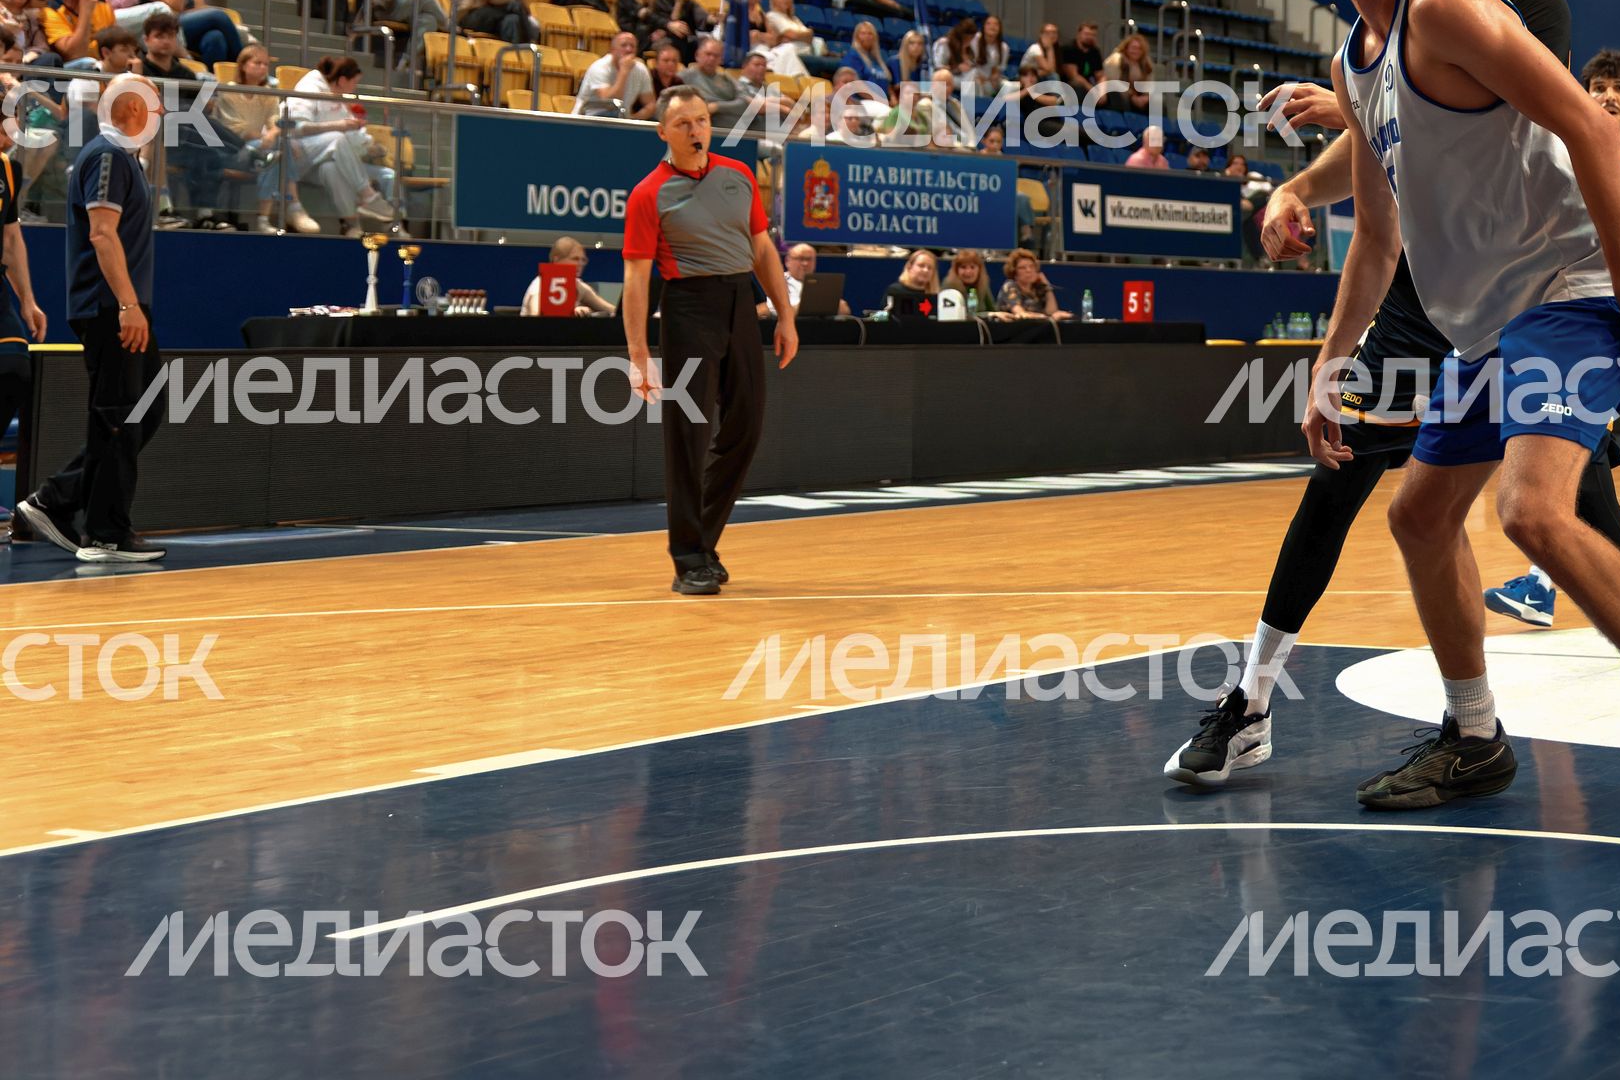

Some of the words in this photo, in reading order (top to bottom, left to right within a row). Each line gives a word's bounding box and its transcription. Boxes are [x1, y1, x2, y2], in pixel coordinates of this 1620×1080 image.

[847, 163, 1001, 193] ПРАВИТЕЛЬСТВО
[847, 188, 980, 214] МОСКОВСКОЙ
[847, 212, 939, 235] ОБЛАСТИ
[1110, 200, 1229, 226] vk.com/khimkibasket
[548, 277, 568, 306] 5
[1128, 291, 1138, 313] 5
[1143, 291, 1152, 313] 5
[1341, 391, 1362, 405] ZEDO
[1540, 402, 1573, 416] ZEDO
